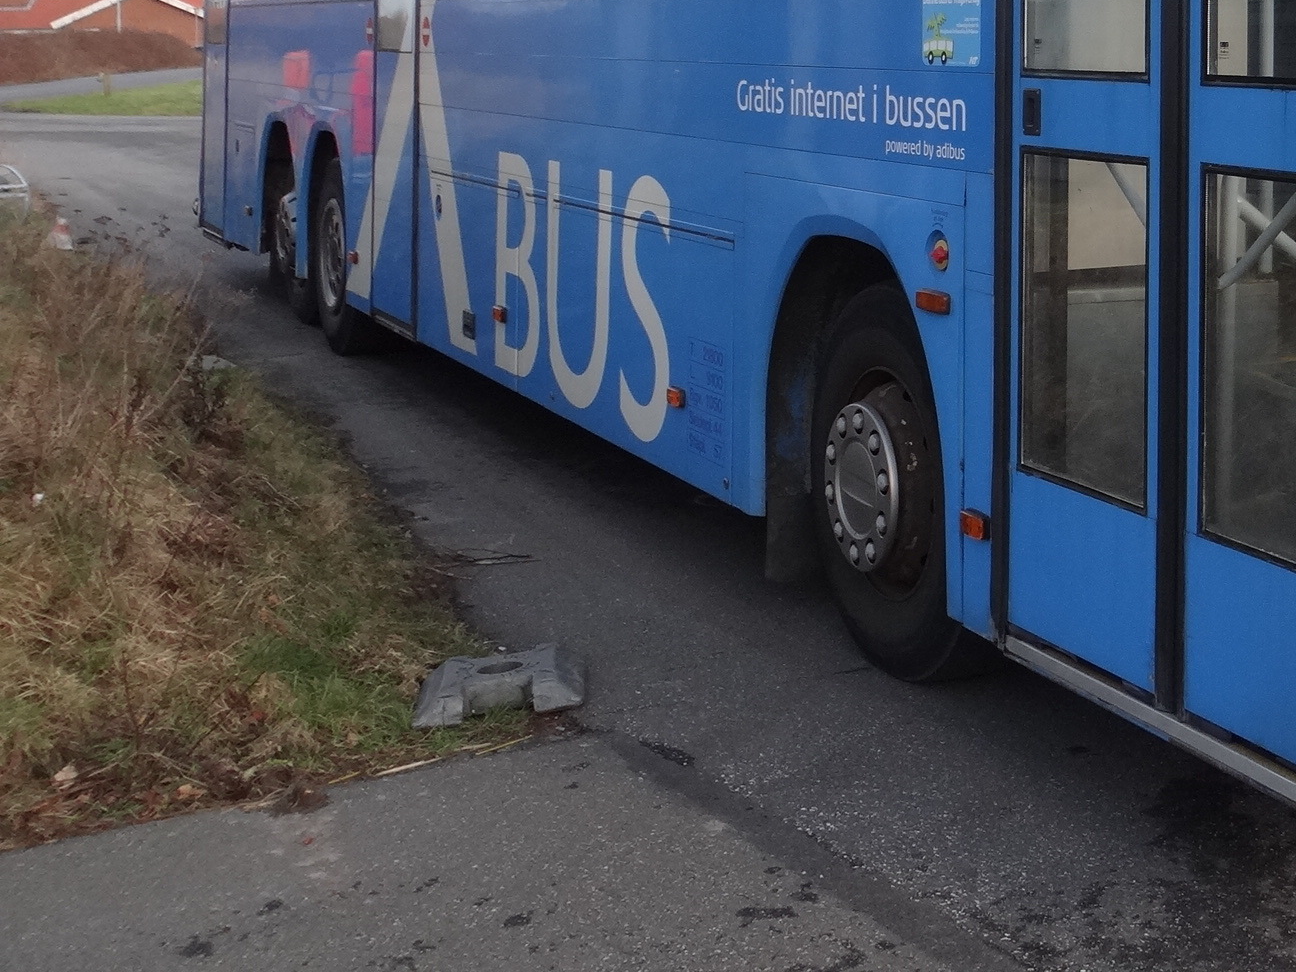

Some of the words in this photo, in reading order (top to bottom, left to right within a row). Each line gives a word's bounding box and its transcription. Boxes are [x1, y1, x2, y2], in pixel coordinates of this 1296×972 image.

[736, 78, 784, 115] Gratis
[790, 79, 866, 124] internet
[872, 84, 878, 125] i
[885, 87, 967, 132] bussen
[885, 140, 921, 157] powered
[923, 142, 935, 160] by
[936, 144, 966, 161] adibus
[494, 151, 671, 443] BUS
